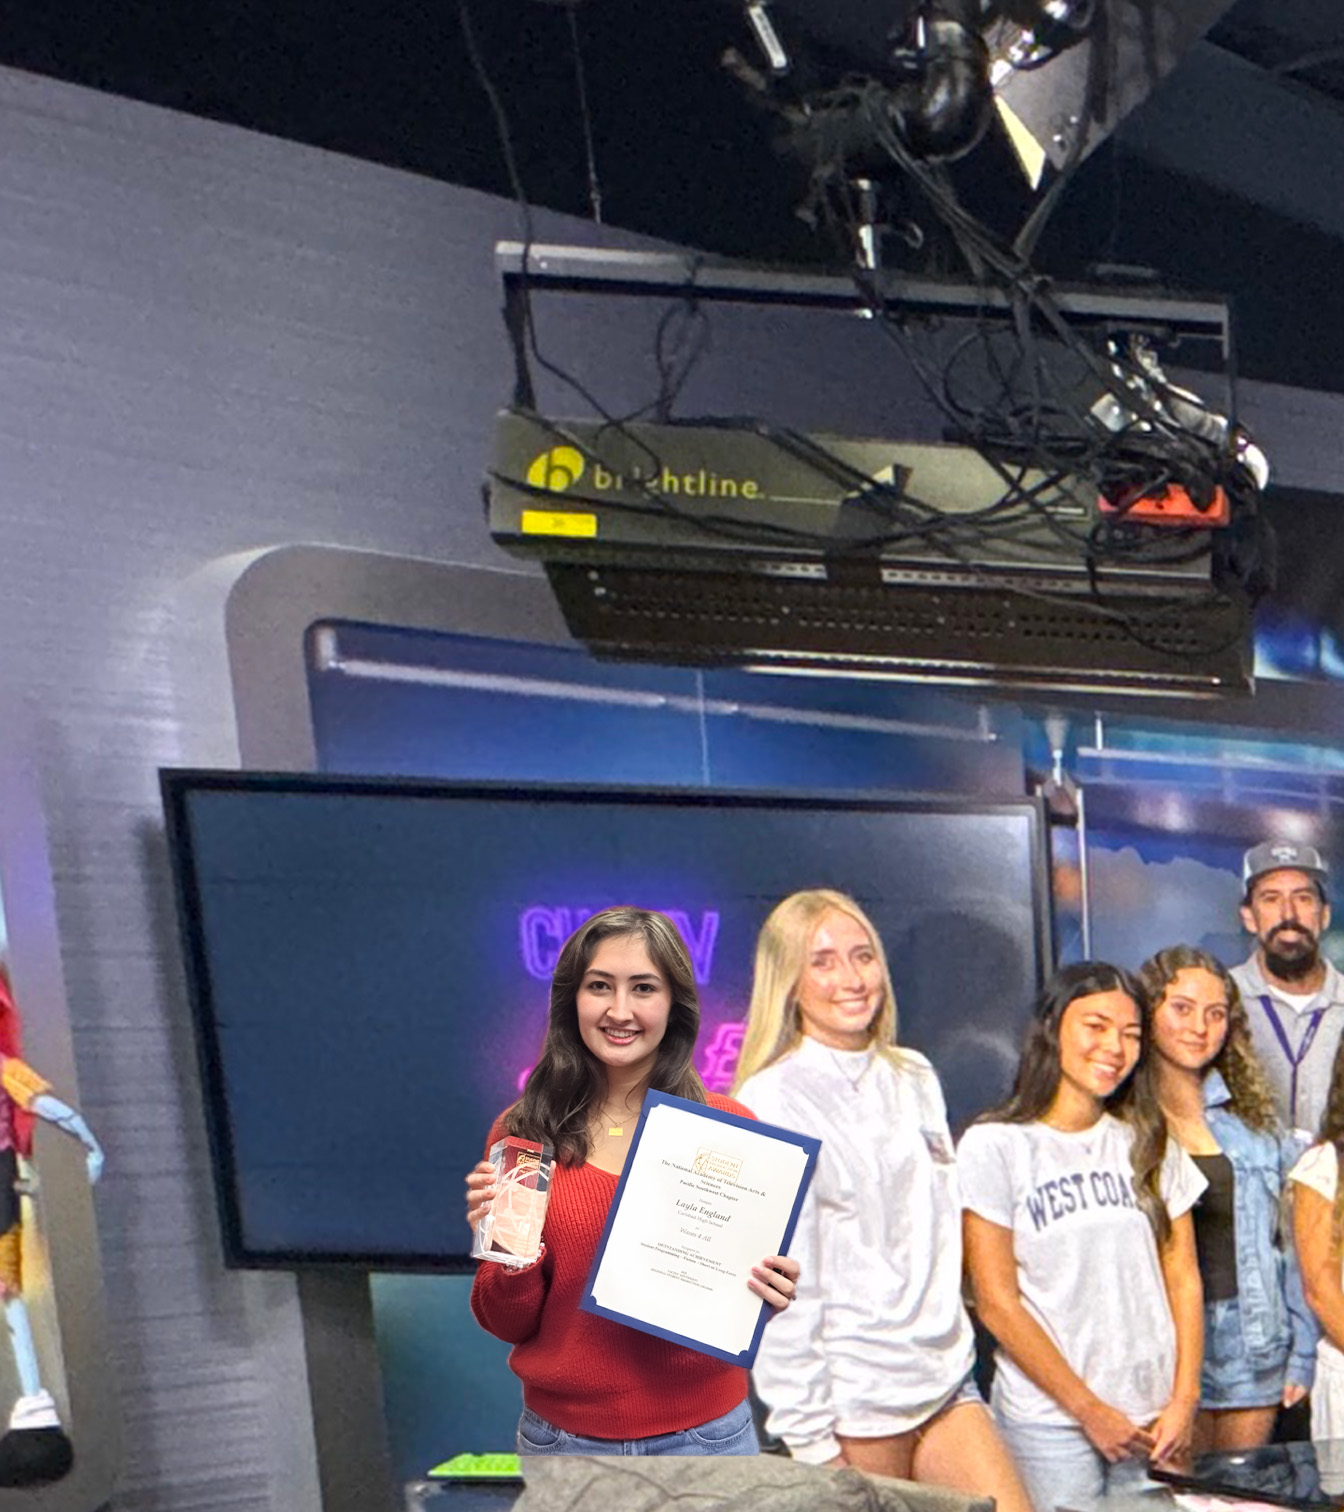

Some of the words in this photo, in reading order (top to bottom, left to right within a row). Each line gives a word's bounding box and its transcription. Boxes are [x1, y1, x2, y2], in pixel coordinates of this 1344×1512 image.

[672, 1162, 693, 1174] National
[694, 1170, 716, 1181] Academy
[723, 1178, 748, 1191] Television
[748, 1187, 760, 1195] Arts
[700, 1179, 721, 1190] Sciences
[679, 1179, 695, 1188] Pacific
[696, 1184, 719, 1196] Southwest
[719, 1191, 739, 1202] Chapter
[1027, 1173, 1087, 1232] WEST
[1089, 1170, 1135, 1209] COA
[675, 1199, 698, 1212] Layla
[699, 1206, 731, 1222] England
[680, 1227, 697, 1238] Waves
[701, 1234, 712, 1242] All
[709, 1219, 724, 1229] School
[654, 1246, 680, 1259] Programming
[657, 1242, 689, 1256] OUTSTANDING
[689, 1253, 722, 1267] ACHIEVEMENT
